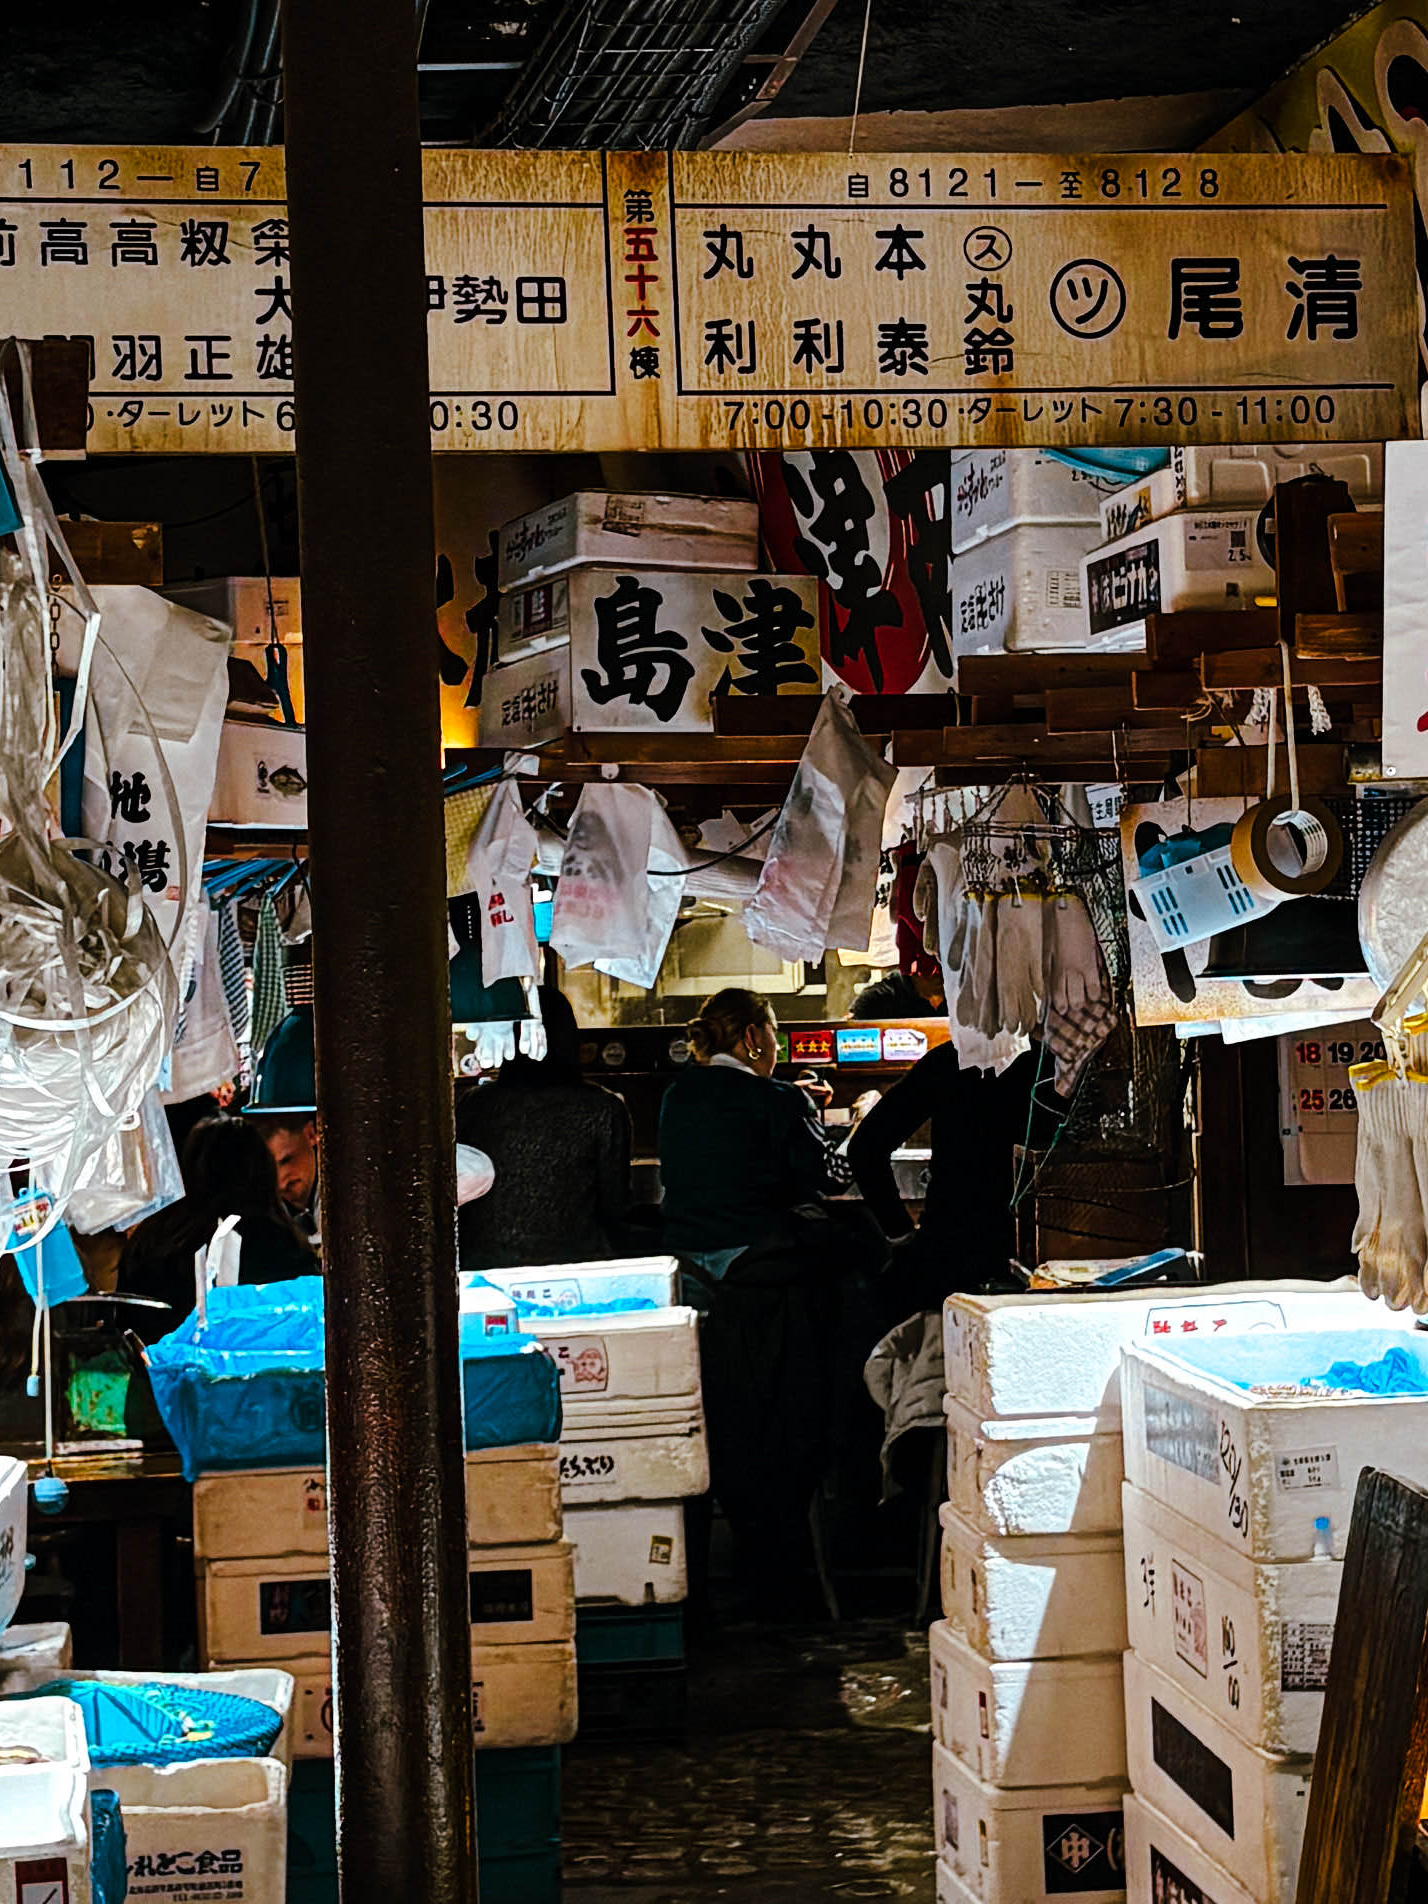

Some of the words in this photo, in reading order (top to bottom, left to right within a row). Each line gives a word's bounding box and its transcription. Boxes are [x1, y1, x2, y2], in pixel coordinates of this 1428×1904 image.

[623, 188, 662, 380] 第五十六棟
[580, 574, 820, 724] 島津
[1295, 1040, 1322, 1066] 18
[1325, 1040, 1355, 1066] 19
[1299, 1089, 1325, 1111] 25
[127, 1849, 244, 1877] れとこ食品
